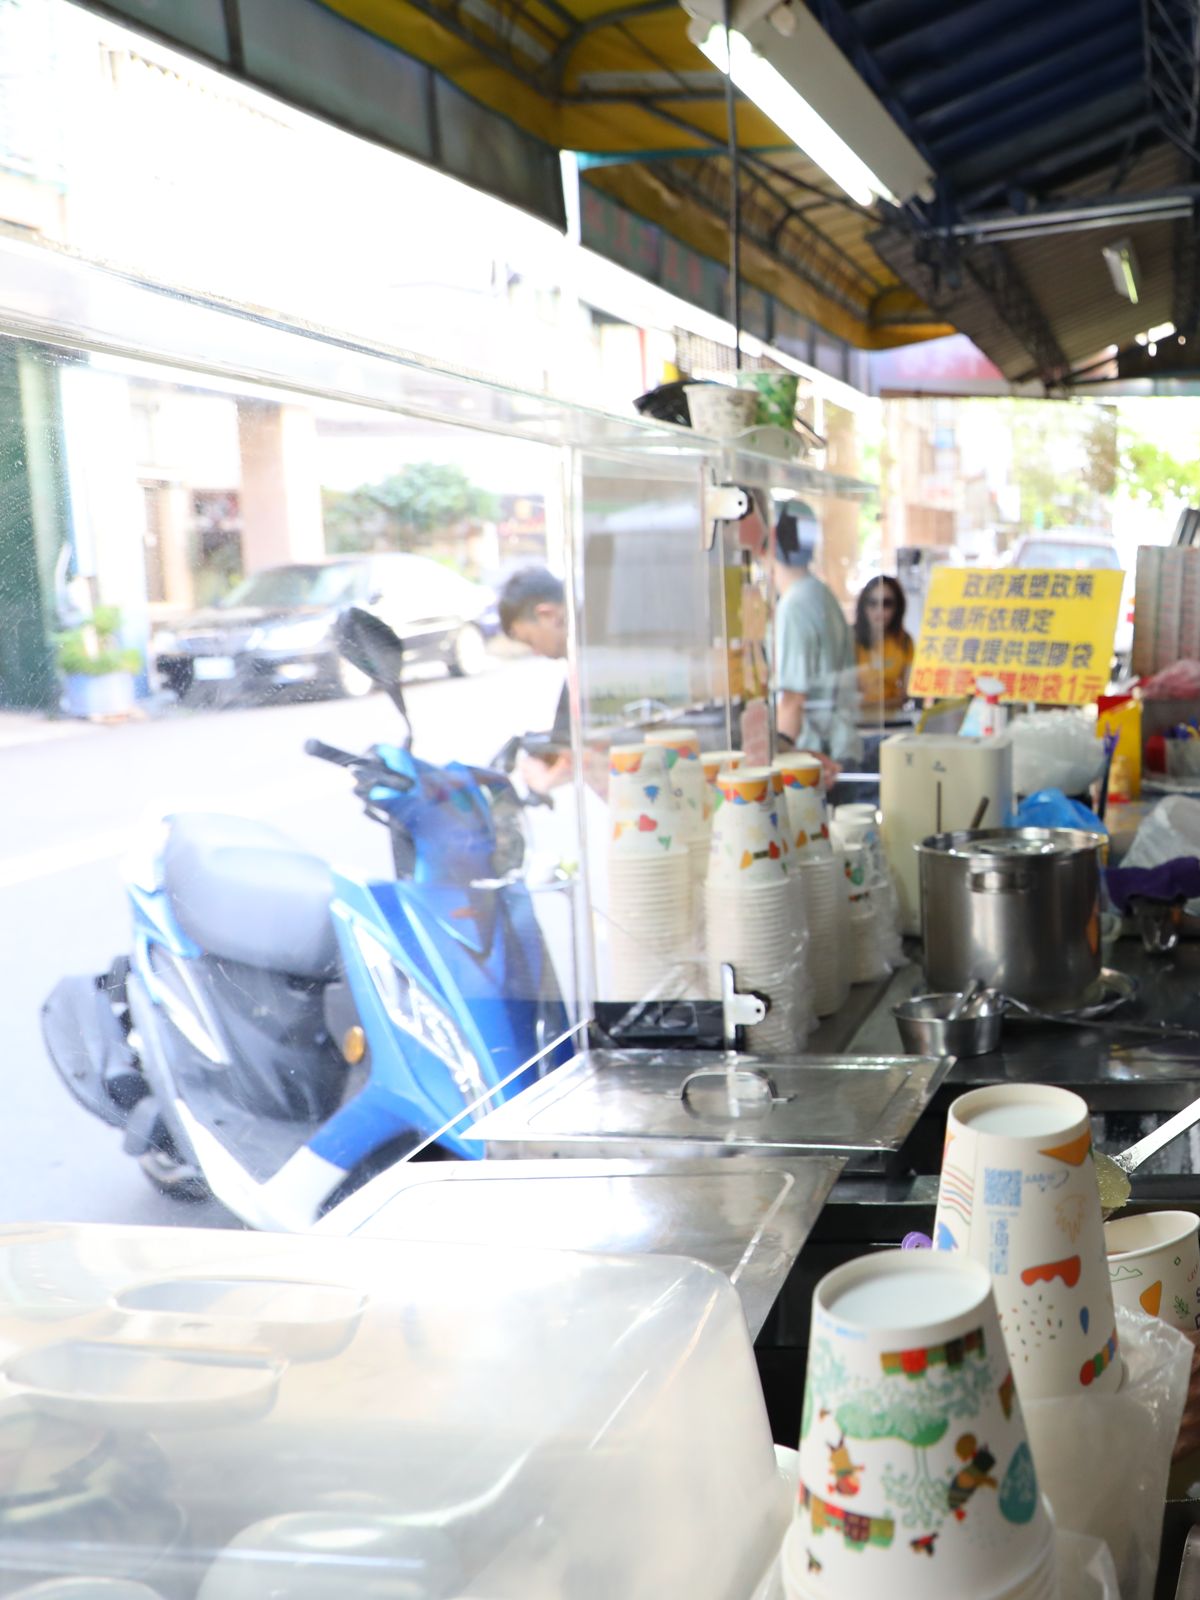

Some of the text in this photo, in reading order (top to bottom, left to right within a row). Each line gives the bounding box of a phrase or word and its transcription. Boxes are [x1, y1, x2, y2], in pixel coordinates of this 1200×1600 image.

[963, 573, 1093, 598] 政府減塑政策
[927, 606, 1053, 633] 本場所依規定
[922, 637, 1093, 668] 不免費提供塑膠袋
